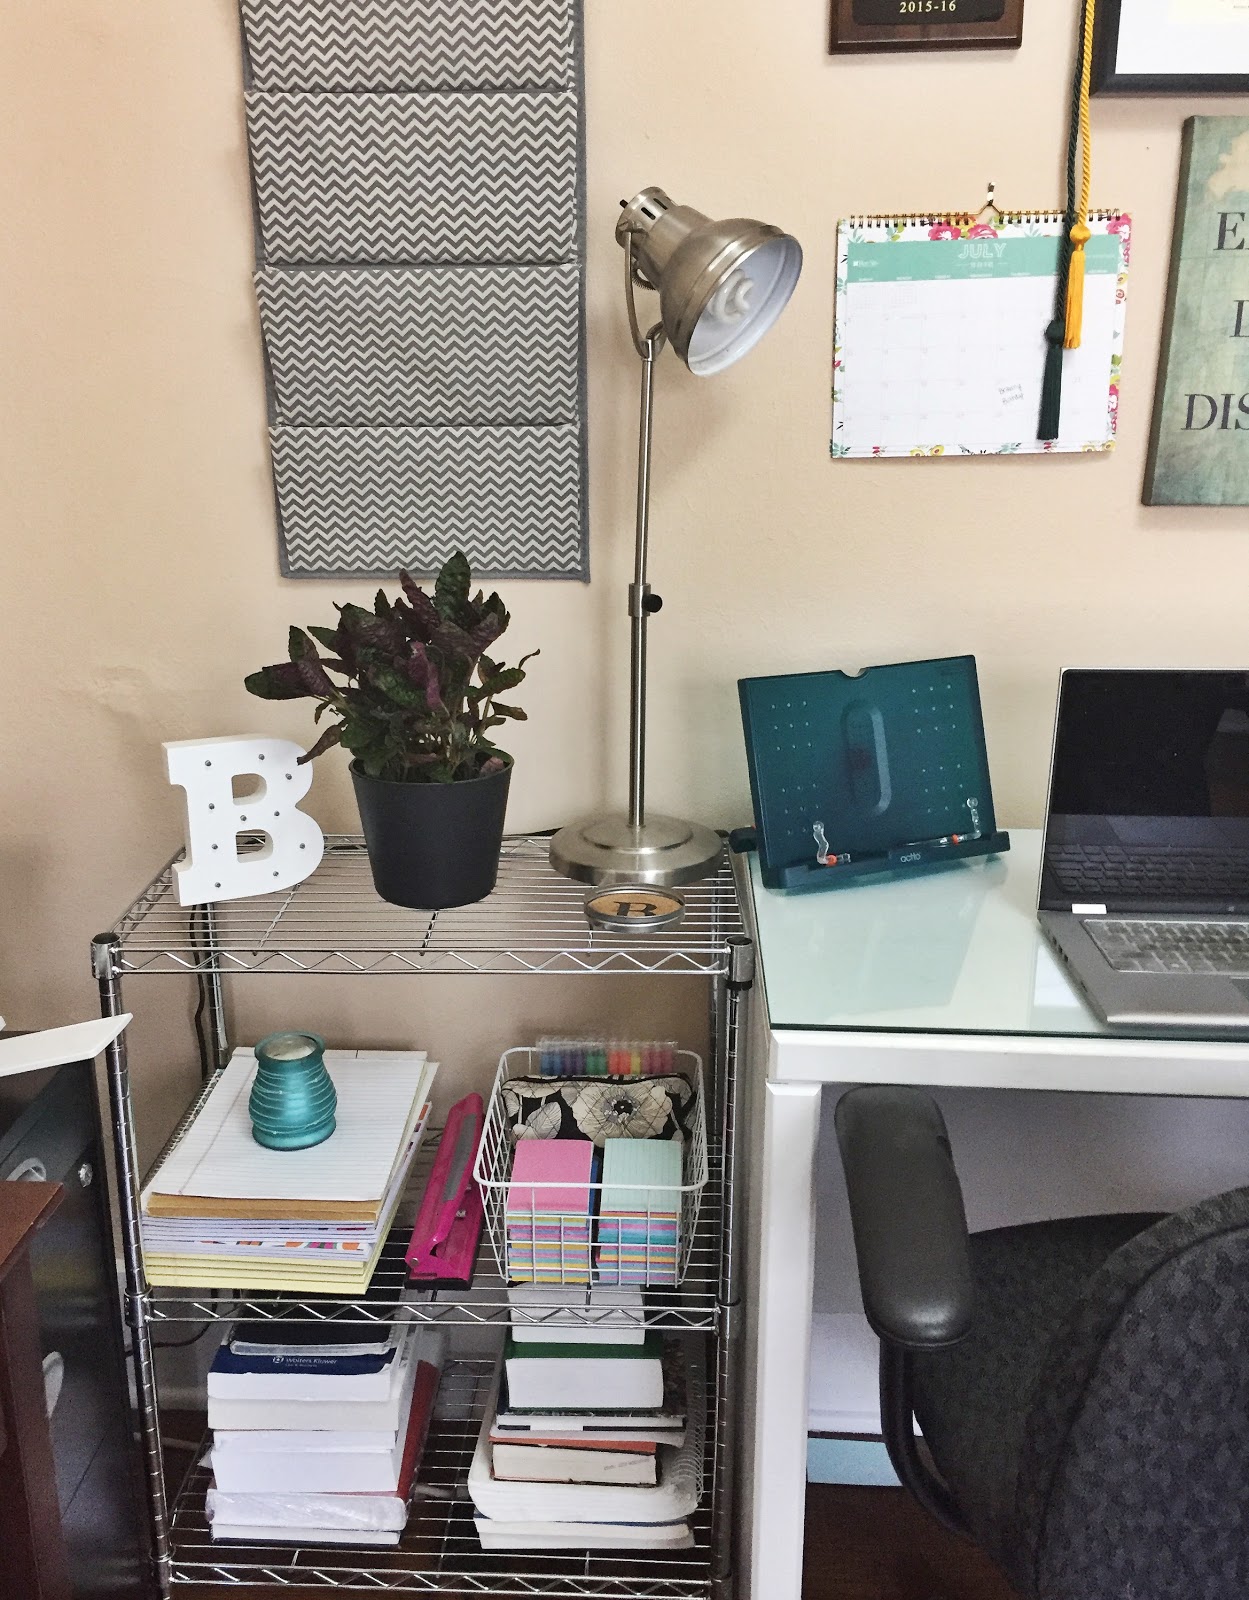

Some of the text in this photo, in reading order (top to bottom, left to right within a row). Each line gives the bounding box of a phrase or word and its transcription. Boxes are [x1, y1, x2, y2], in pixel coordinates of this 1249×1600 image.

[900, 0, 956, 13] 2015-16
[1213, 212, 1249, 250] E
[958, 242, 1007, 259] JULY
[161, 733, 325, 907] B
